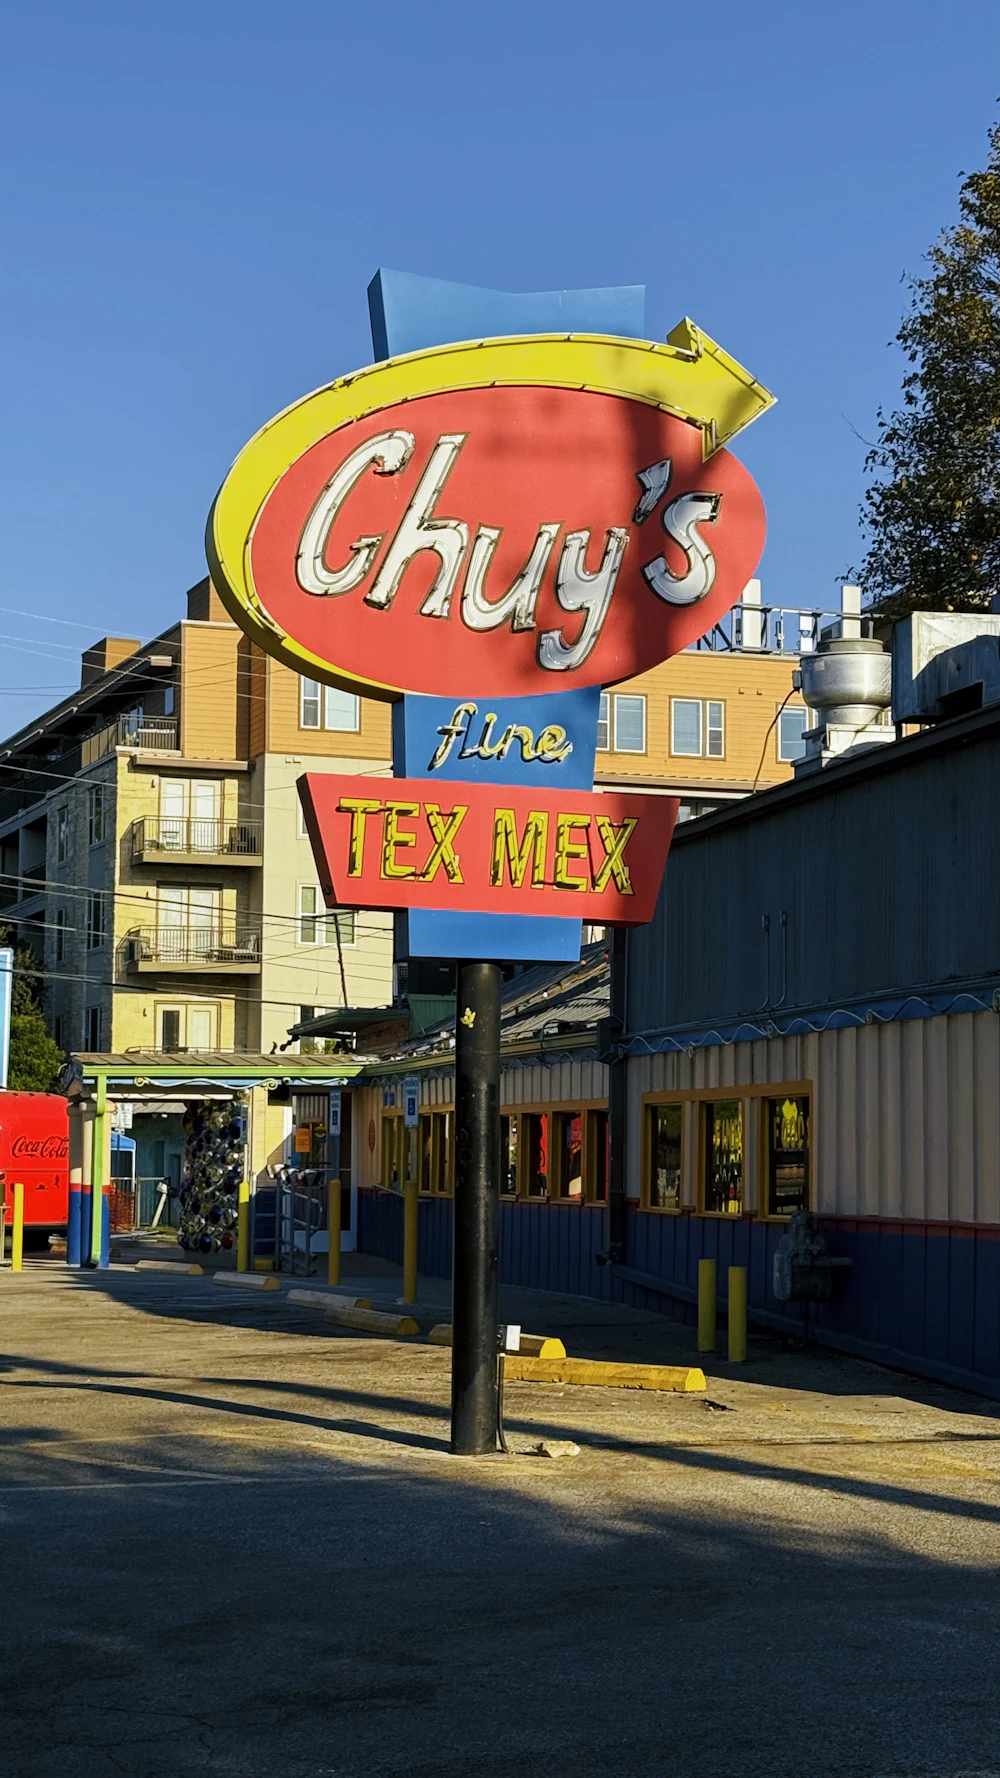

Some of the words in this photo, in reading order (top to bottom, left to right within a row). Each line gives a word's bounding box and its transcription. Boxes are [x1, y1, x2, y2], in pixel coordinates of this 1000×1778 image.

[295, 429, 723, 672] Chuy's
[428, 702, 573, 770] fine
[339, 797, 468, 885] TEX
[489, 808, 638, 896] MEX
[11, 1135, 69, 1158] Coca-Cola
